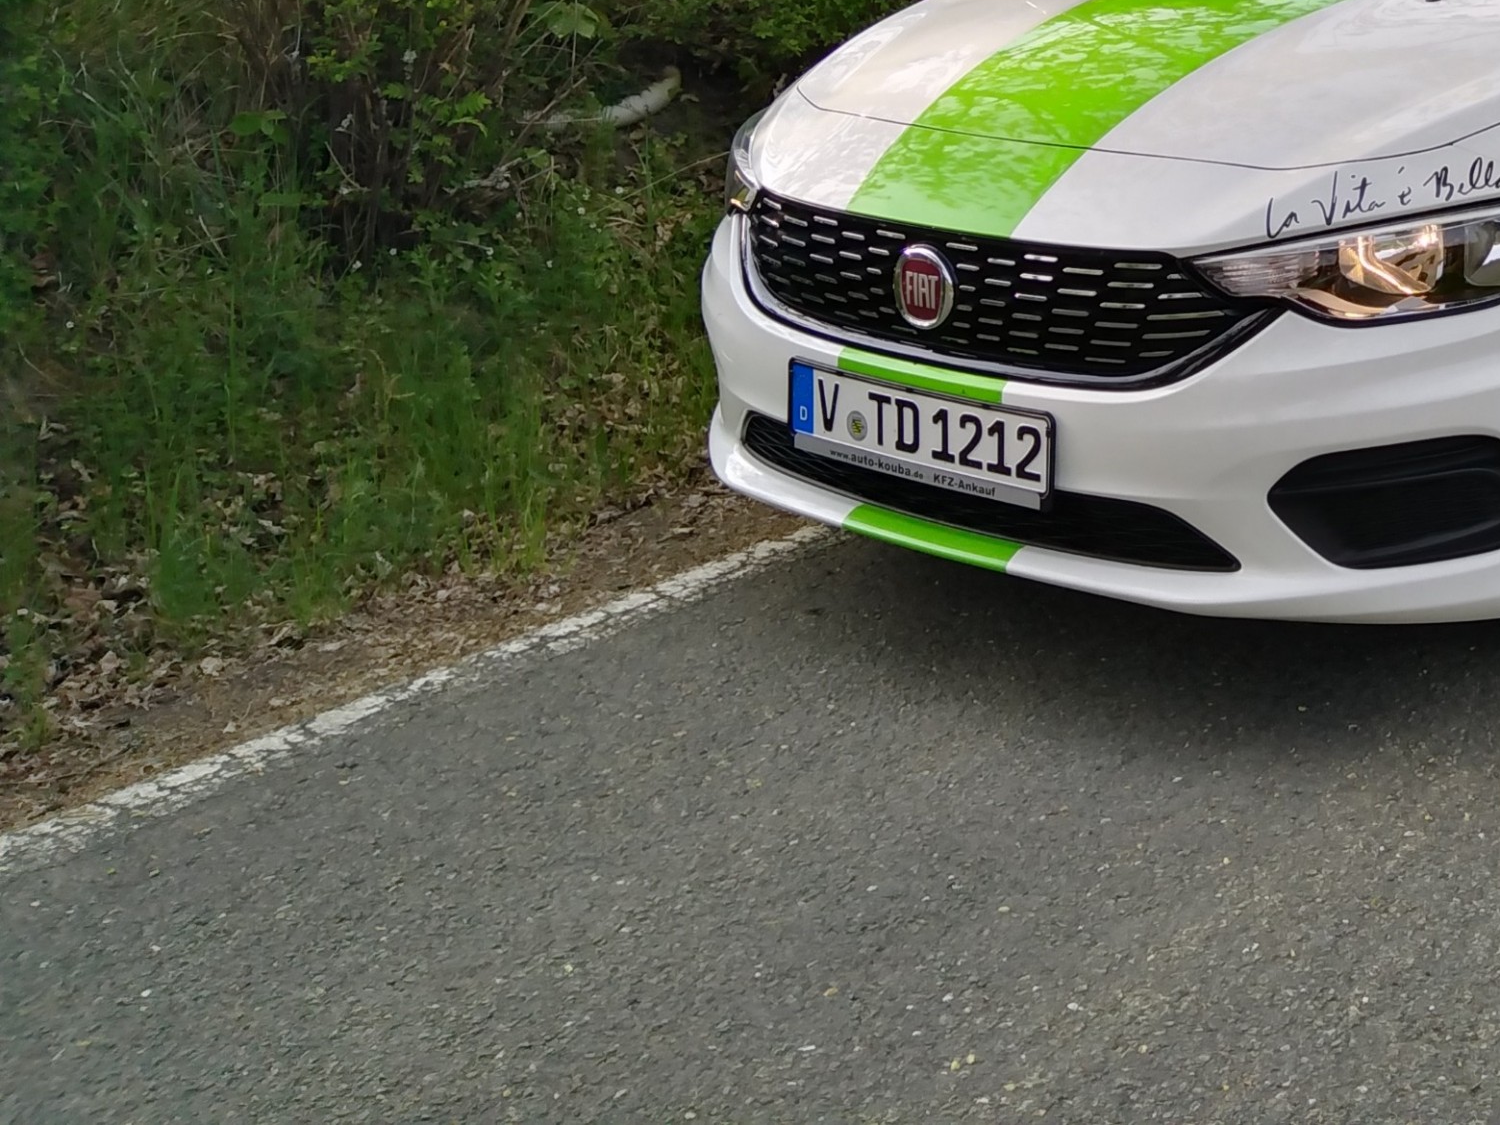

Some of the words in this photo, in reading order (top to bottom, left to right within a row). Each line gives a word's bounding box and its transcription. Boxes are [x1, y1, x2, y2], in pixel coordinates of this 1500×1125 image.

[1311, 171, 1386, 226] Vita
[905, 270, 939, 310] FIAT
[800, 405, 807, 421] D
[818, 378, 839, 432] V
[868, 391, 919, 453] TD
[931, 408, 1042, 482] 1212
[829, 448, 924, 480] www.auto-kouba.de
[933, 473, 996, 497] KFZ-Ankauf
